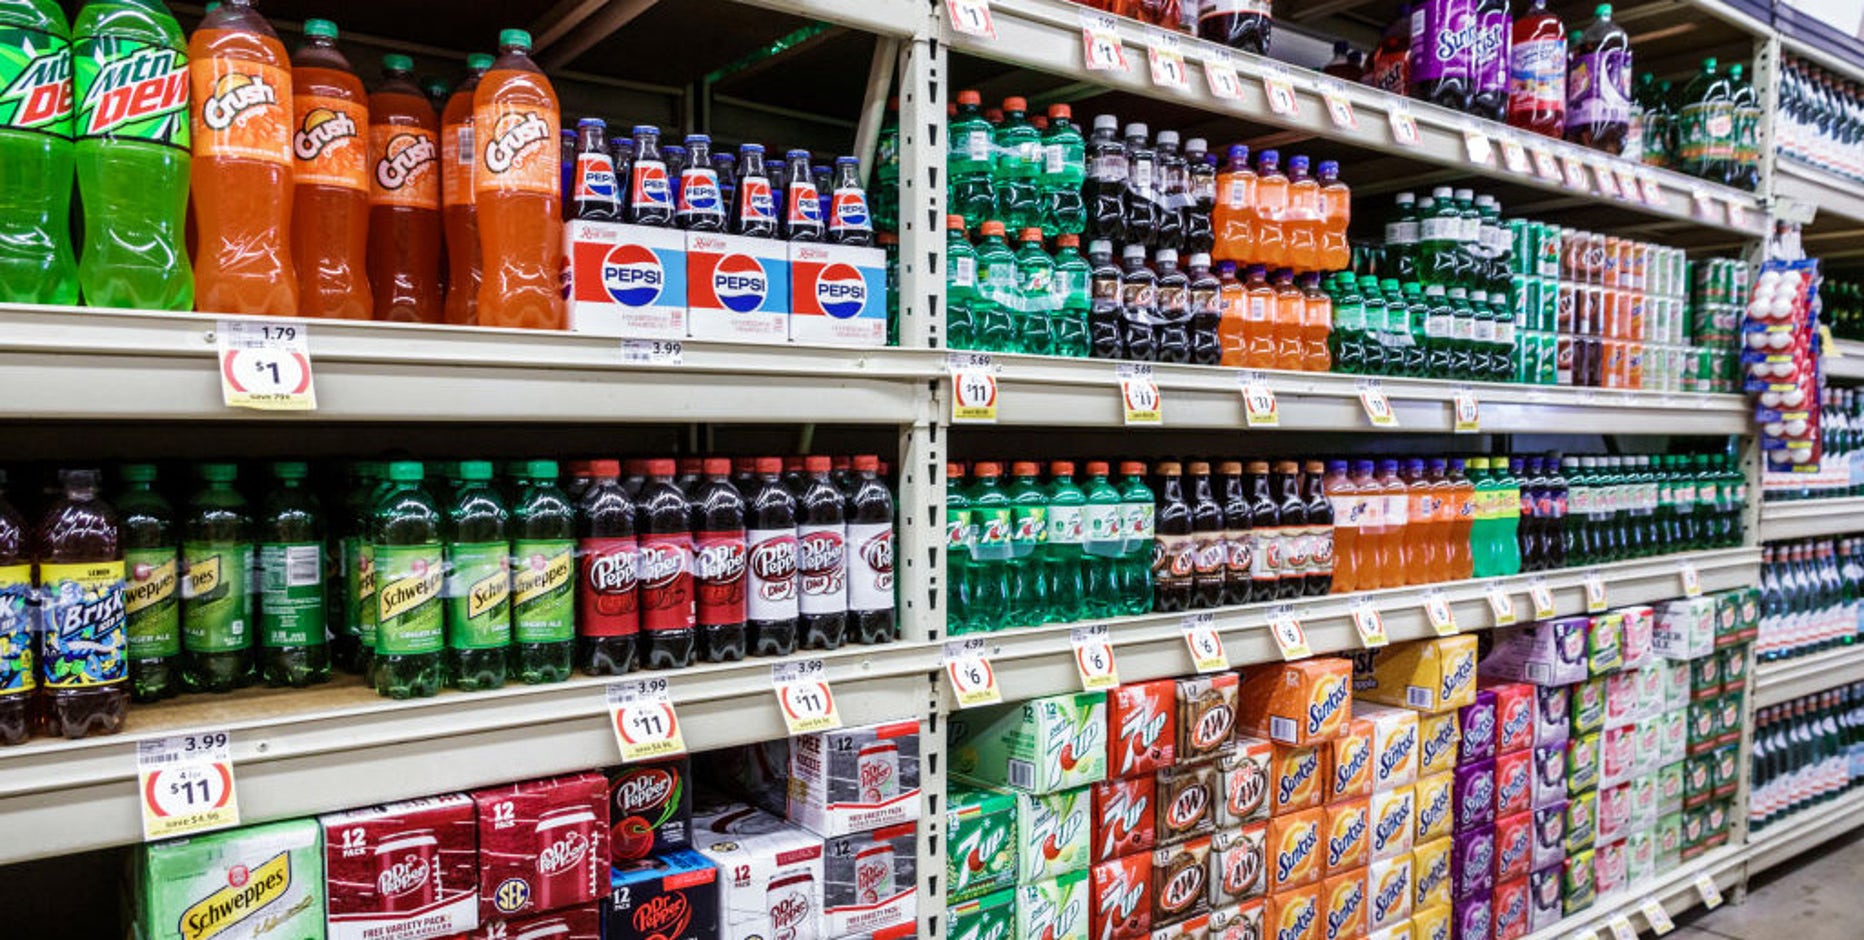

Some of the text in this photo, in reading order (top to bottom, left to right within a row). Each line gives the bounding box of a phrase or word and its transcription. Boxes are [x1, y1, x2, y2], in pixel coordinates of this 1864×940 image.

[18, 50, 71, 91] Mt
[89, 52, 172, 100] Mtn
[20, 81, 73, 126] De
[204, 74, 277, 130] Crush
[294, 111, 357, 160] Crush
[485, 111, 550, 173] Crush
[376, 135, 437, 190] Crush
[605, 267, 662, 285] PEPSI
[715, 276, 765, 292] PEPSI
[818, 284, 865, 300] PEPSI
[262, 327, 296, 341] 1.79
[652, 343, 682, 355] 3.99
[255, 361, 280, 384] $1
[716, 545, 737, 562] Dr
[800, 542, 841, 571] Pepper
[813, 539, 833, 554] Dr
[598, 557, 637, 590] Pepp
[761, 547, 796, 577] Pepp
[126, 573, 175, 604] weppes
[768, 584, 787, 596] Diet
[806, 578, 824, 591] Diet
[61, 588, 125, 636] Brisk
[798, 660, 823, 673] 3.99
[638, 679, 667, 694] 3.99
[795, 694, 822, 711] $11
[1023, 705, 1034, 718] 12
[1045, 702, 1057, 714] 12
[1308, 675, 1349, 734] Sunkist
[633, 715, 663, 735] $11
[1199, 706, 1230, 743] A&W
[185, 733, 227, 751] 3.99
[837, 737, 853, 751] 12
[1048, 722, 1098, 790] 7UP
[1121, 708, 1167, 774] 7UP
[1378, 724, 1416, 780] Sunkist
[1279, 747, 1318, 804] Sunkist
[1335, 738, 1372, 793] Sunkist
[170, 779, 210, 804] $11
[624, 779, 668, 809] Pepper
[637, 775, 656, 791] Dr
[493, 801, 515, 820] 12
[1175, 788, 1203, 821] A&W
[1101, 795, 1147, 860] 7UP
[1375, 793, 1410, 851] Sunkist
[342, 827, 366, 849] 12
[835, 842, 850, 856] 12
[1030, 810, 1083, 883] 7UP
[1277, 822, 1319, 883] Sunkist
[1328, 810, 1367, 867] Sunkist
[957, 825, 1006, 891] 7UP
[1161, 849, 1169, 861] 12
[735, 865, 750, 881] 12
[1169, 865, 1203, 904] A&W
[187, 867, 285, 937] Schweppes
[498, 880, 526, 910] SEC
[613, 887, 631, 904] 12
[652, 895, 671, 911] Dr
[1027, 887, 1038, 900] 12
[1375, 866, 1408, 923] Sunkist
[386, 920, 422, 935] VARIETY
[423, 916, 446, 927] PACK
[639, 899, 683, 931] Pepper
[1327, 881, 1363, 940] Sunkist
[486, 920, 507, 940] 12
